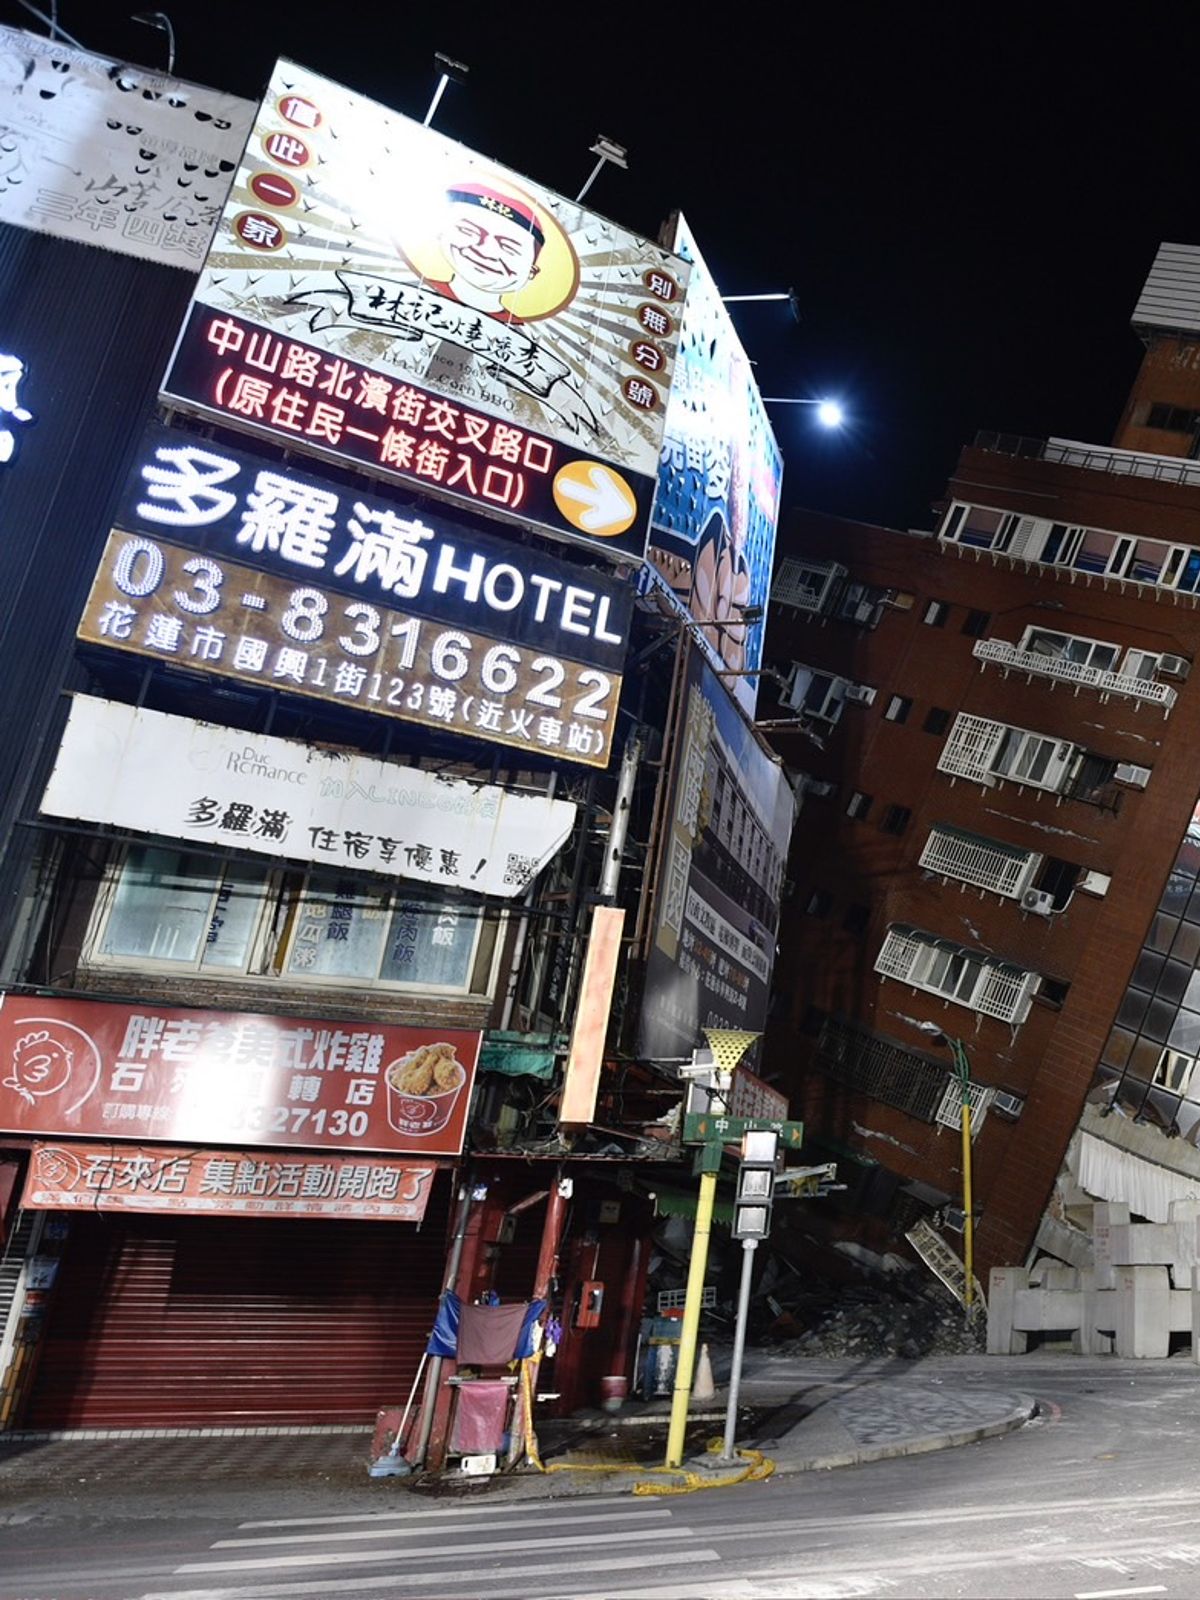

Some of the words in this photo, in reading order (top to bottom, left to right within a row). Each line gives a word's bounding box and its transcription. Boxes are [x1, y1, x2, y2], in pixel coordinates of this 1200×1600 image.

[206, 318, 554, 475] 中山路北濱街交叉路口
[479, 388, 516, 412] BBQ
[628, 274, 672, 408] 別無分號
[137, 444, 434, 600] 多羅滿
[432, 544, 623, 645] HOTEL
[112, 537, 612, 721] 03-8316622
[186, 797, 292, 843] 多羅滿
[82, 1153, 191, 1194] 石來店
[201, 1157, 434, 1201] 集點活動開跑了
